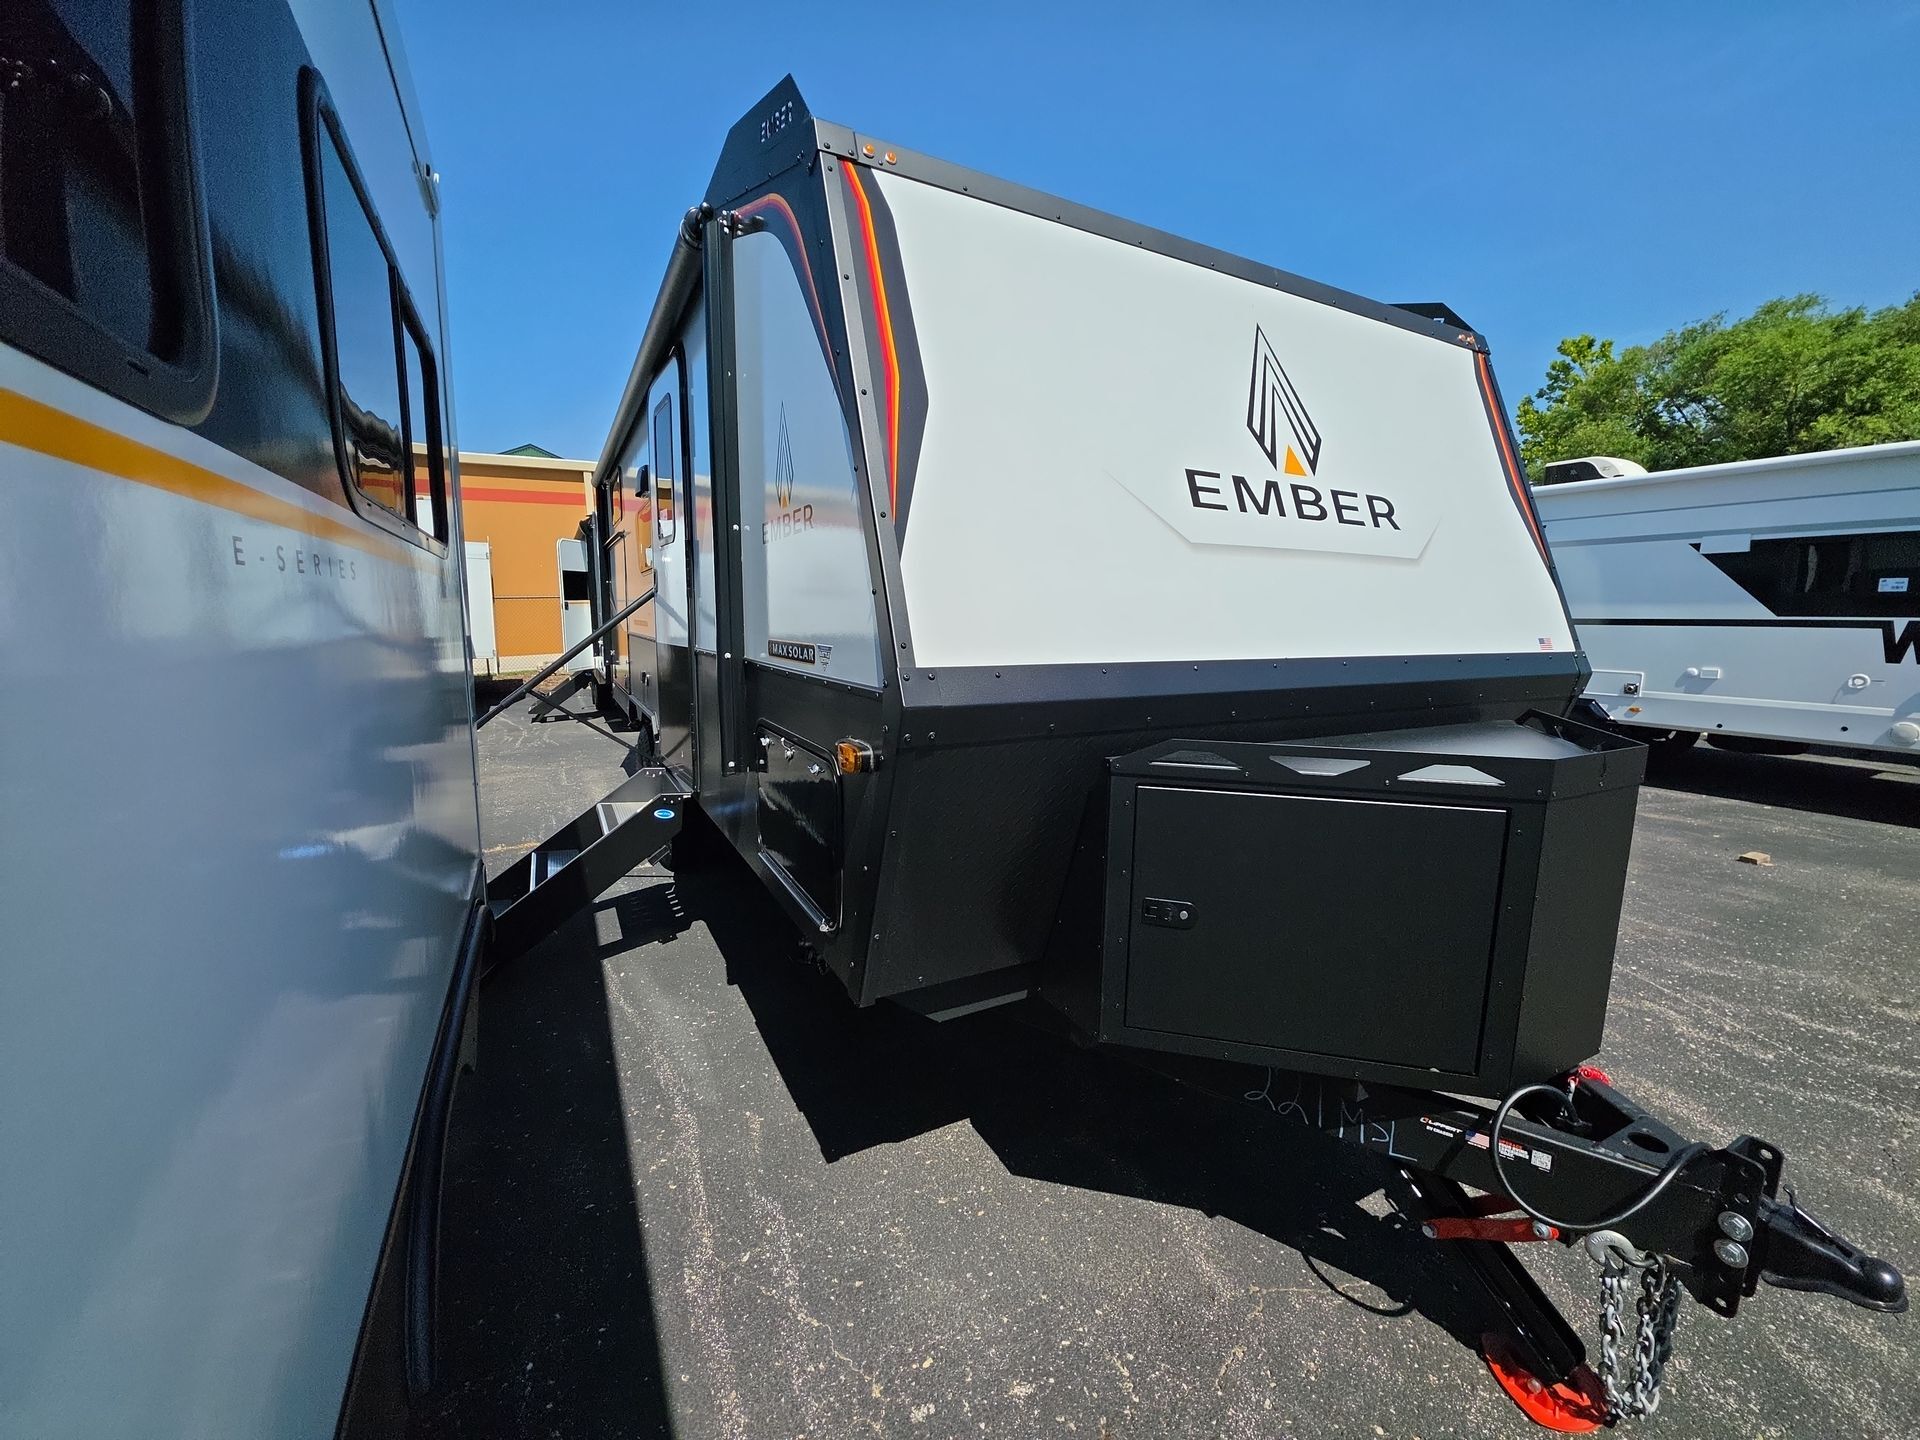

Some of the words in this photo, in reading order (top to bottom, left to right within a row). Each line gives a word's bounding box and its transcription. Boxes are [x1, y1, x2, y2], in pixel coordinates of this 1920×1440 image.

[1184, 468, 1401, 531] EMBER
[762, 504, 814, 545] EMBER
[772, 643, 788, 656] MAX
[788, 645, 814, 661] SOLAR
